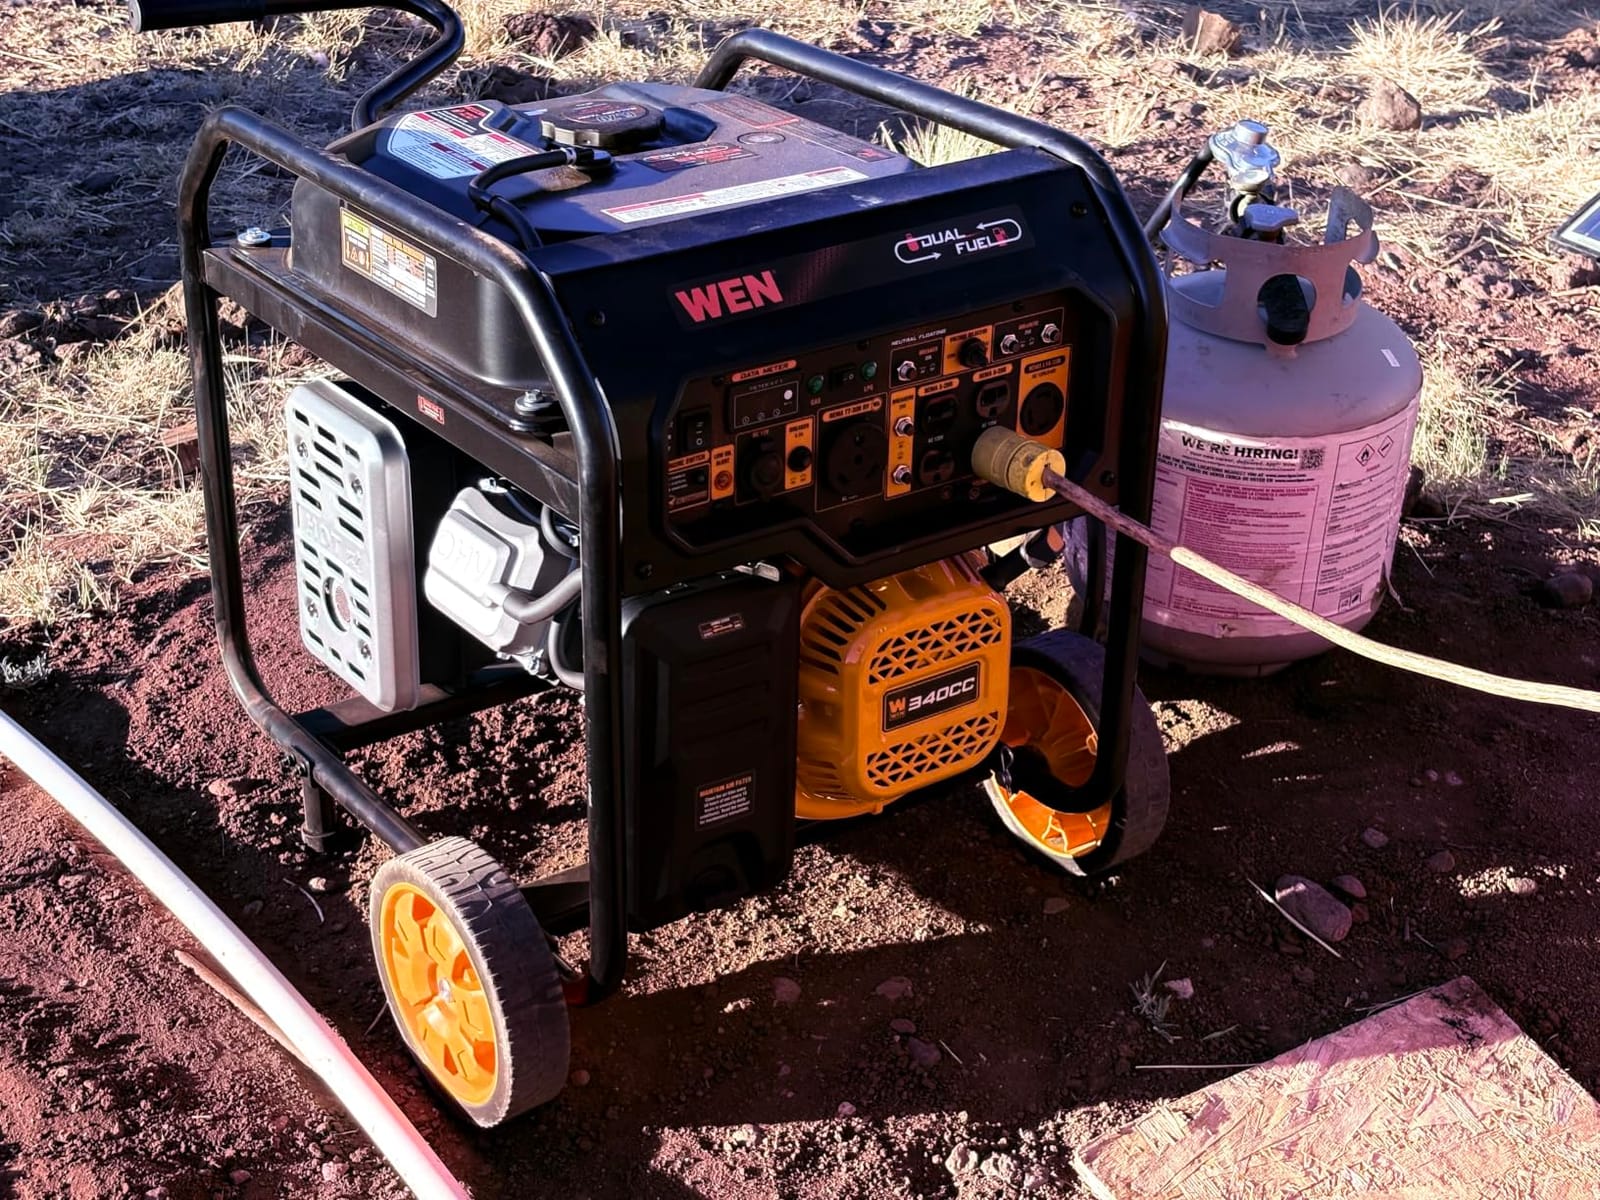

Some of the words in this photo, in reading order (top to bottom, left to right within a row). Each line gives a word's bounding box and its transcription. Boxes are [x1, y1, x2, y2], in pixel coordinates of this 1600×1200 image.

[921, 228, 966, 248] DUAL
[955, 235, 996, 255] FUEL
[674, 269, 784, 323] WEN
[890, 337, 917, 346] NEUTRAL
[918, 328, 947, 340] FLOATING
[740, 371, 759, 379] DATA
[763, 364, 789, 373] METER
[1182, 435, 1231, 456] WE'RE
[1234, 446, 1299, 460] HIRING!
[908, 676, 976, 712] 340CC
[699, 784, 725, 798] MAINTAIN
[726, 780, 734, 789] AIR
[735, 775, 752, 786] FILTER
